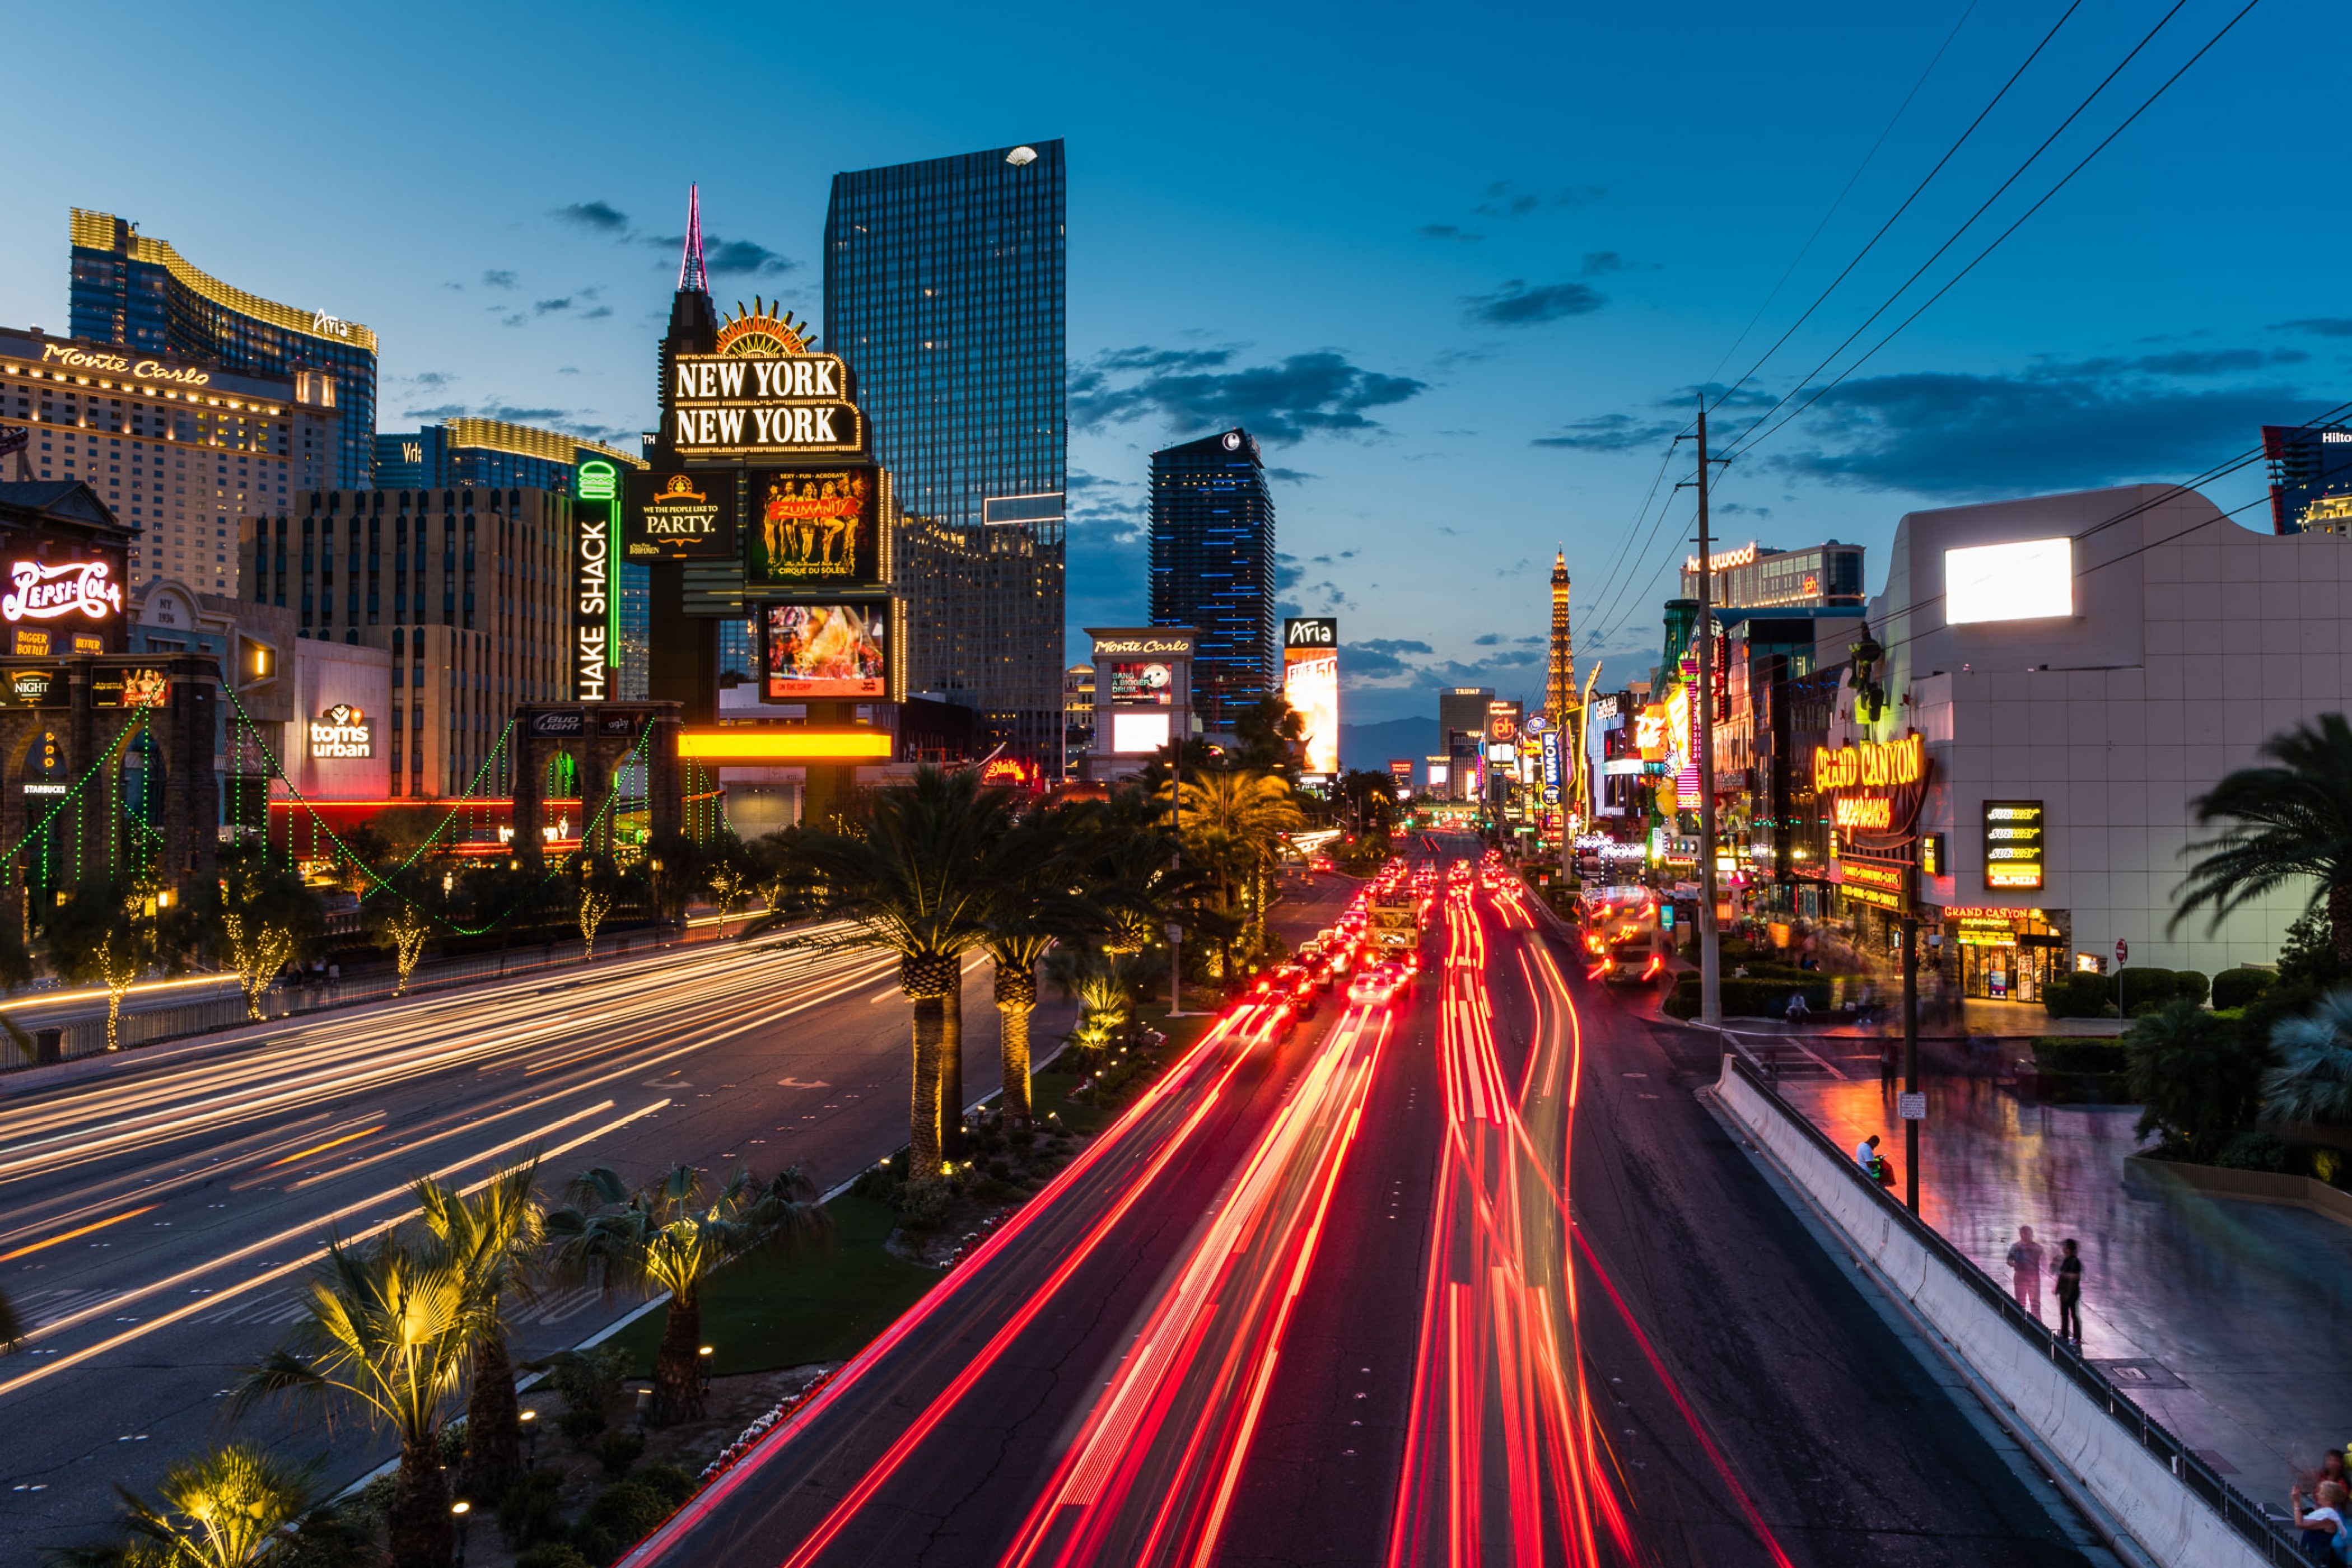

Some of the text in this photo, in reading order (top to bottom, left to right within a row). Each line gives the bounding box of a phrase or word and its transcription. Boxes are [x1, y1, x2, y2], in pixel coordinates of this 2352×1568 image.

[313, 309, 347, 337] Aria
[43, 343, 209, 385] Monte Carlo
[676, 361, 837, 397] NEW YORK
[676, 408, 837, 444] NEW YORK
[2322, 433, 2352, 443] Hilto
[778, 500, 849, 516] ZUMANITY
[646, 515, 716, 533] PARTY.
[581, 521, 606, 614] SHACK
[1688, 542, 1755, 576] hoywood
[779, 567, 806, 576] CIRQUE
[160, 599, 172, 609] NY
[17, 631, 48, 644] BIGGER
[1290, 621, 1331, 645] Aria
[1095, 640, 1189, 654] Monte Carlo
[580, 626, 605, 701] HAKE
[15, 683, 49, 693] NIGHT
[310, 722, 368, 742] toms
[314, 741, 370, 757] urban
[1546, 734, 1556, 782] ROSS
[1816, 734, 1919, 794] GRAND CANYON
[1944, 906, 2028, 918] GRAND CANYON
[1961, 918, 2009, 927] experience
